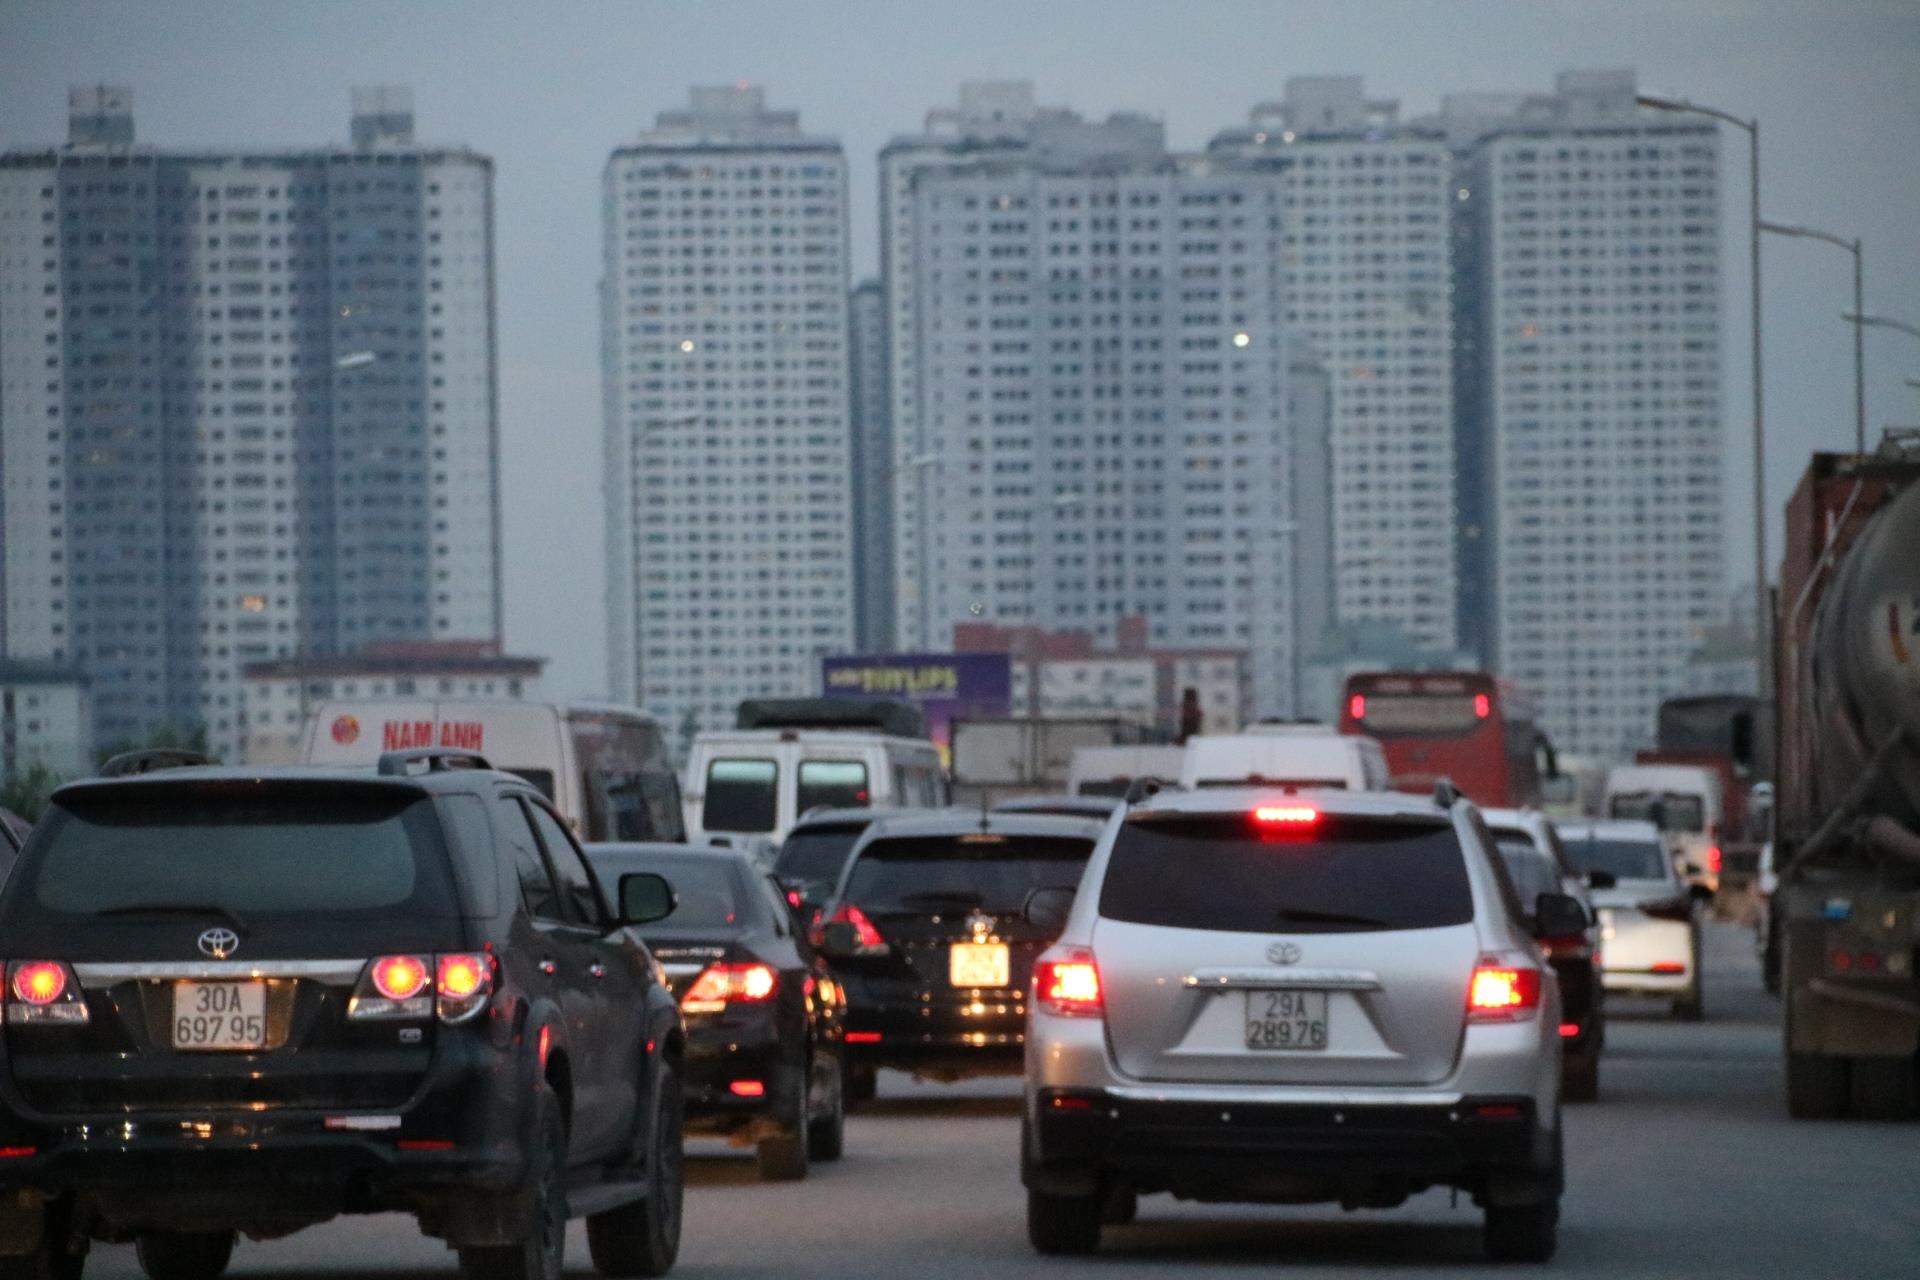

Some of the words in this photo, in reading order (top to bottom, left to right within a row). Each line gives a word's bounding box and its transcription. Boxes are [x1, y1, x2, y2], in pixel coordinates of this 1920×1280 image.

[383, 720, 433, 750] NAM
[440, 720, 483, 750] ANH
[196, 985, 242, 1013] 30A
[1264, 992, 1306, 1019] 29A
